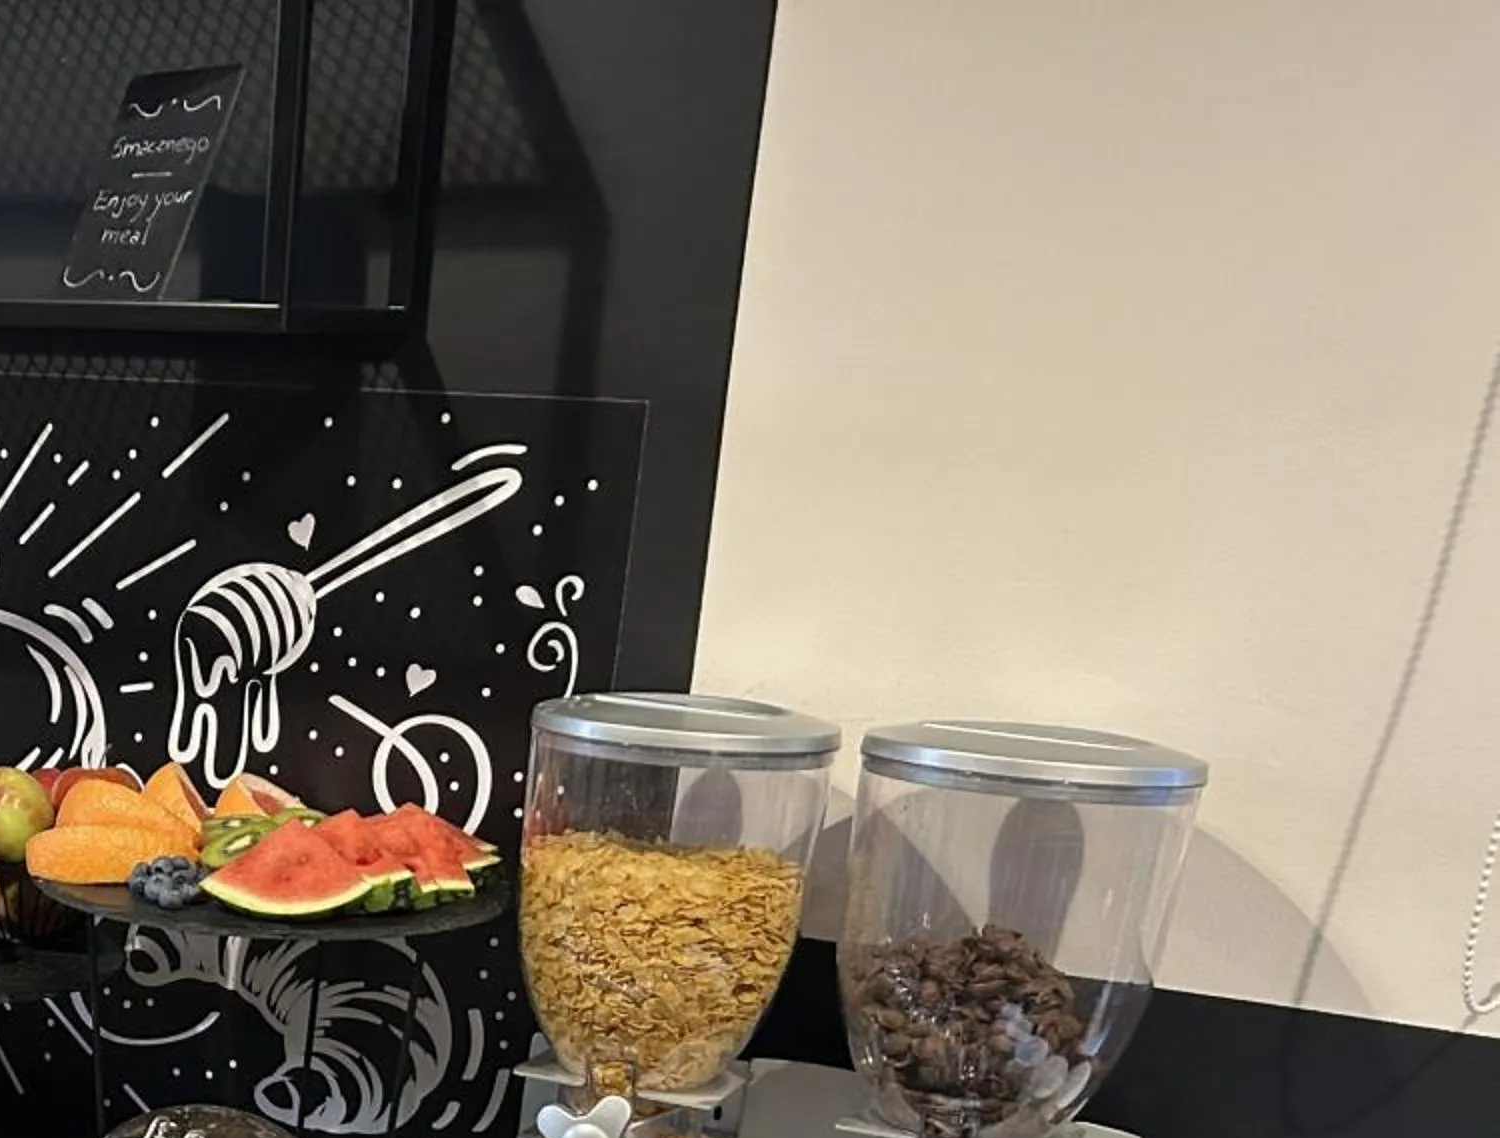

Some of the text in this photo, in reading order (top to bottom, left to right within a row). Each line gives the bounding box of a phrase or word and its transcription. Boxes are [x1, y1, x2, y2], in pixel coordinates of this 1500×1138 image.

[93, 189, 193, 224] Enjoy your
[101, 223, 151, 246] meal
